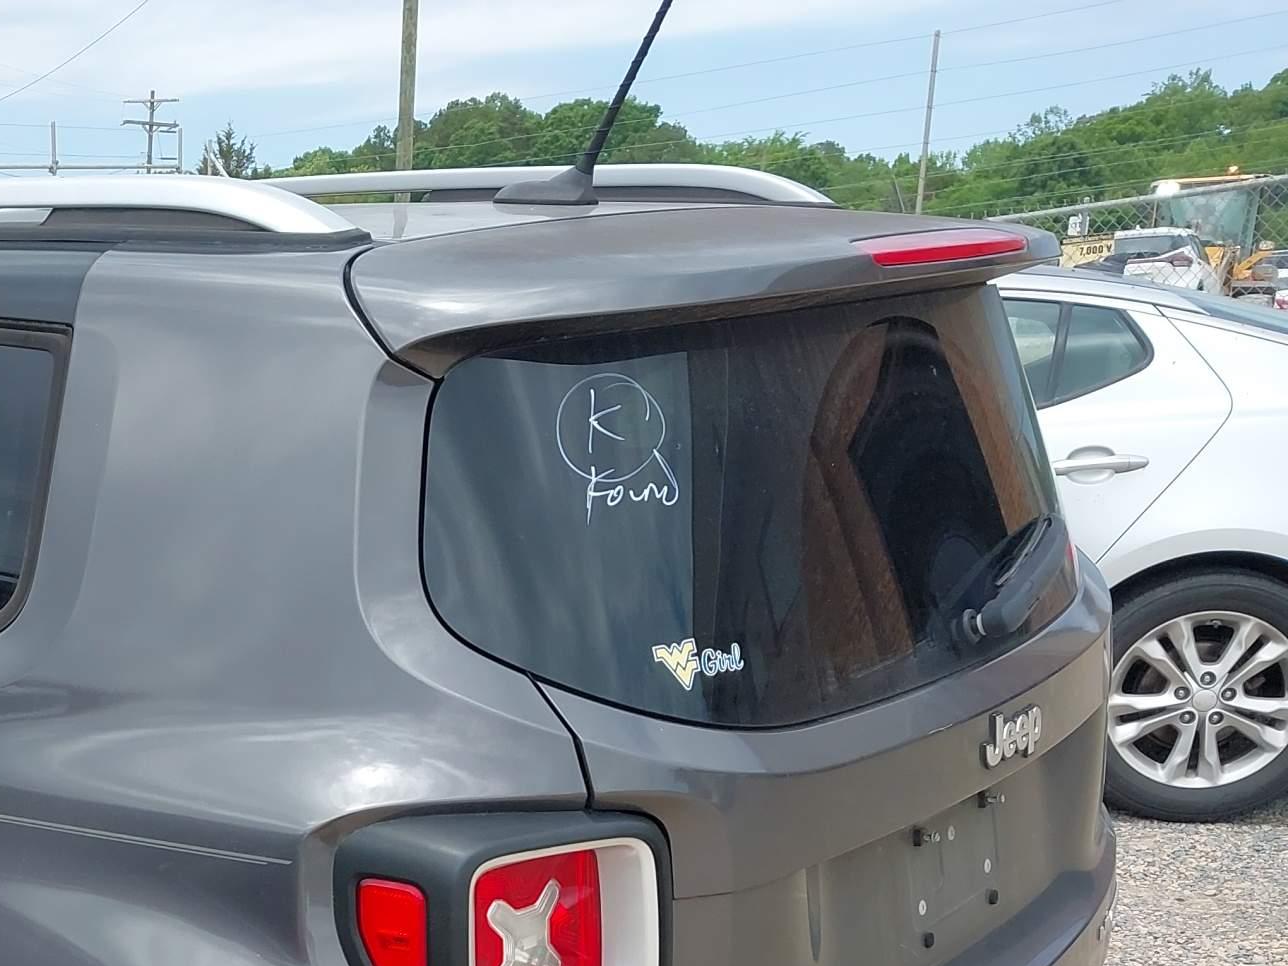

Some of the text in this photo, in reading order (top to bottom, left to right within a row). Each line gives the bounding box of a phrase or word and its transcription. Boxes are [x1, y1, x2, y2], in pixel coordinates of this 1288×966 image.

[1079, 244, 1104, 257] 7,000
[589, 389, 625, 453] K
[700, 643, 744, 676] Girl
[980, 704, 1042, 769] Jeep
